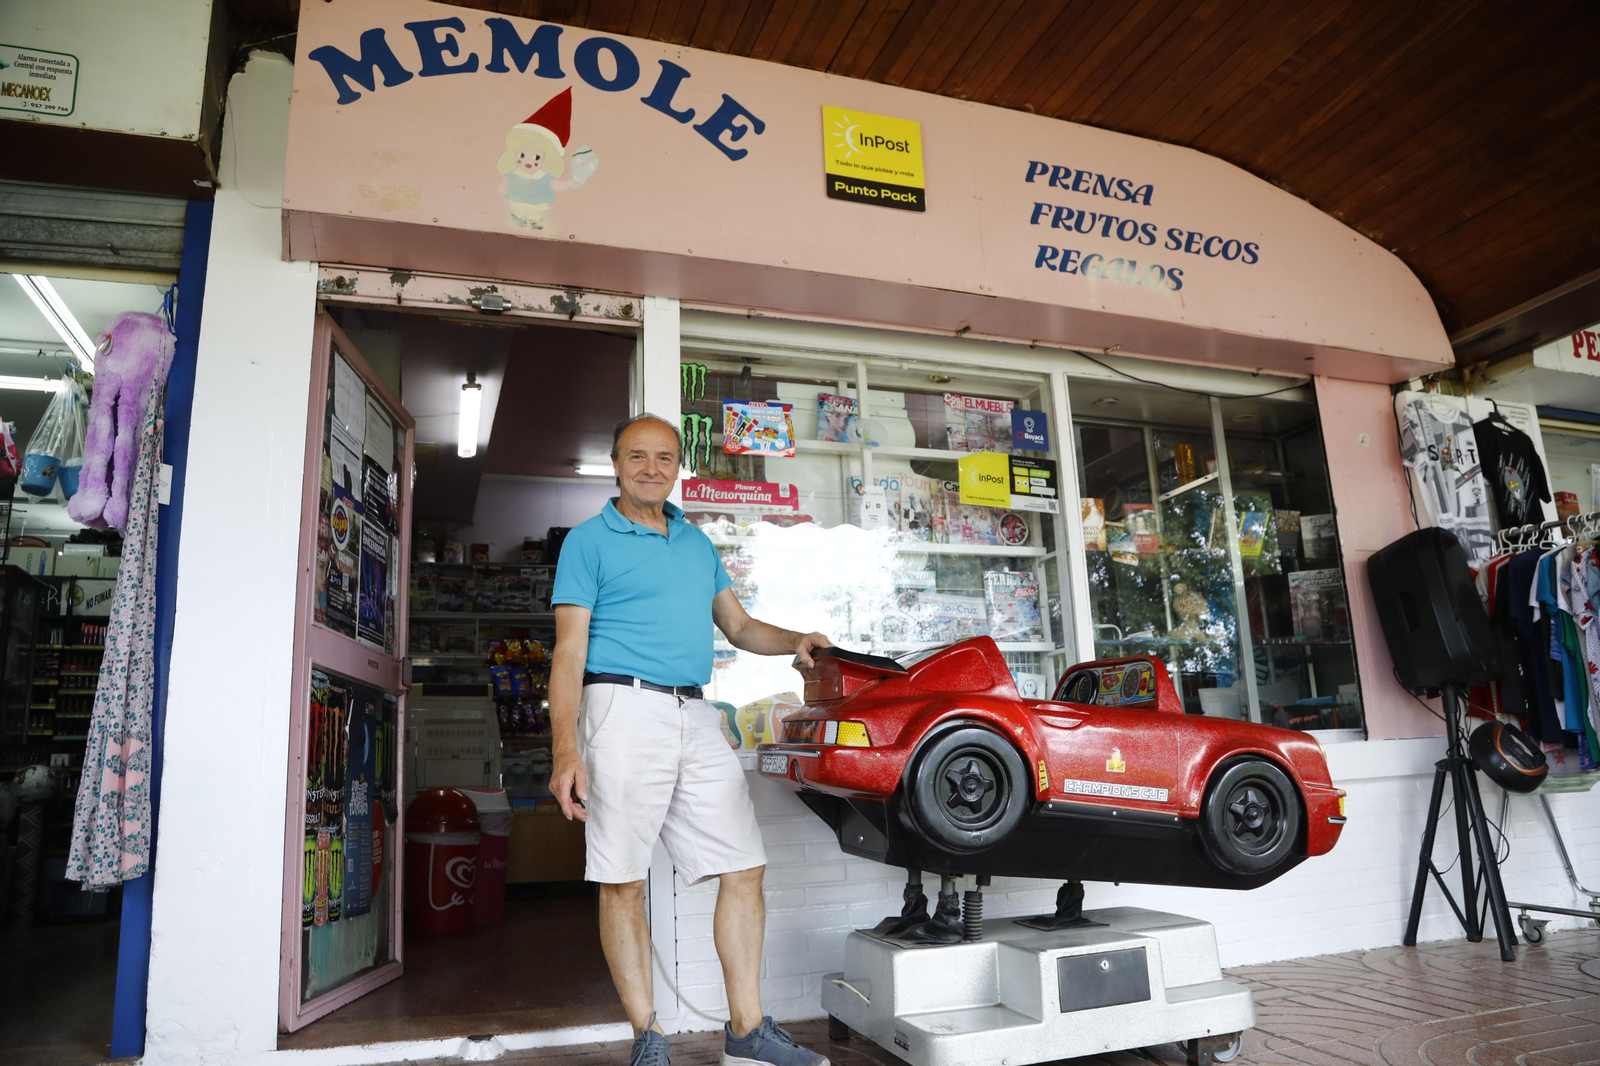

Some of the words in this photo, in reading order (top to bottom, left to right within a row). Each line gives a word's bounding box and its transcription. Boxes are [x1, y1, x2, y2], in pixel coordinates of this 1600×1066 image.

[14, 61, 34, 69] Central
[46, 66, 72, 75] respuesta
[17, 54, 37, 62] Alarma
[38, 58, 66, 66] conectada
[29, 70, 56, 80] inmediata
[1, 82, 52, 102] MECANOEX
[308, 17, 766, 161] MEMOLE
[860, 132, 910, 153] InPost
[875, 166, 893, 174] pides
[835, 181, 878, 197] Punto
[881, 188, 917, 203] Pack
[1025, 160, 1154, 206] PRENSA
[1030, 202, 1158, 246] FRUTOS
[1164, 228, 1260, 265] SECOS
[1034, 244, 1184, 292] REGALOS
[1572, 331, 1600, 362] PE
[1024, 433, 1044, 442] Boyacá
[979, 474, 1004, 484] InPost
[686, 487, 698, 498] la
[698, 484, 772, 503] Menorquina
[86, 598, 93, 610] NO
[94, 589, 112, 606] FUMAR
[957, 604, 978, 615] Cruz
[1065, 780, 1140, 797] CHAMPION'S
[1141, 788, 1167, 800] CUP
